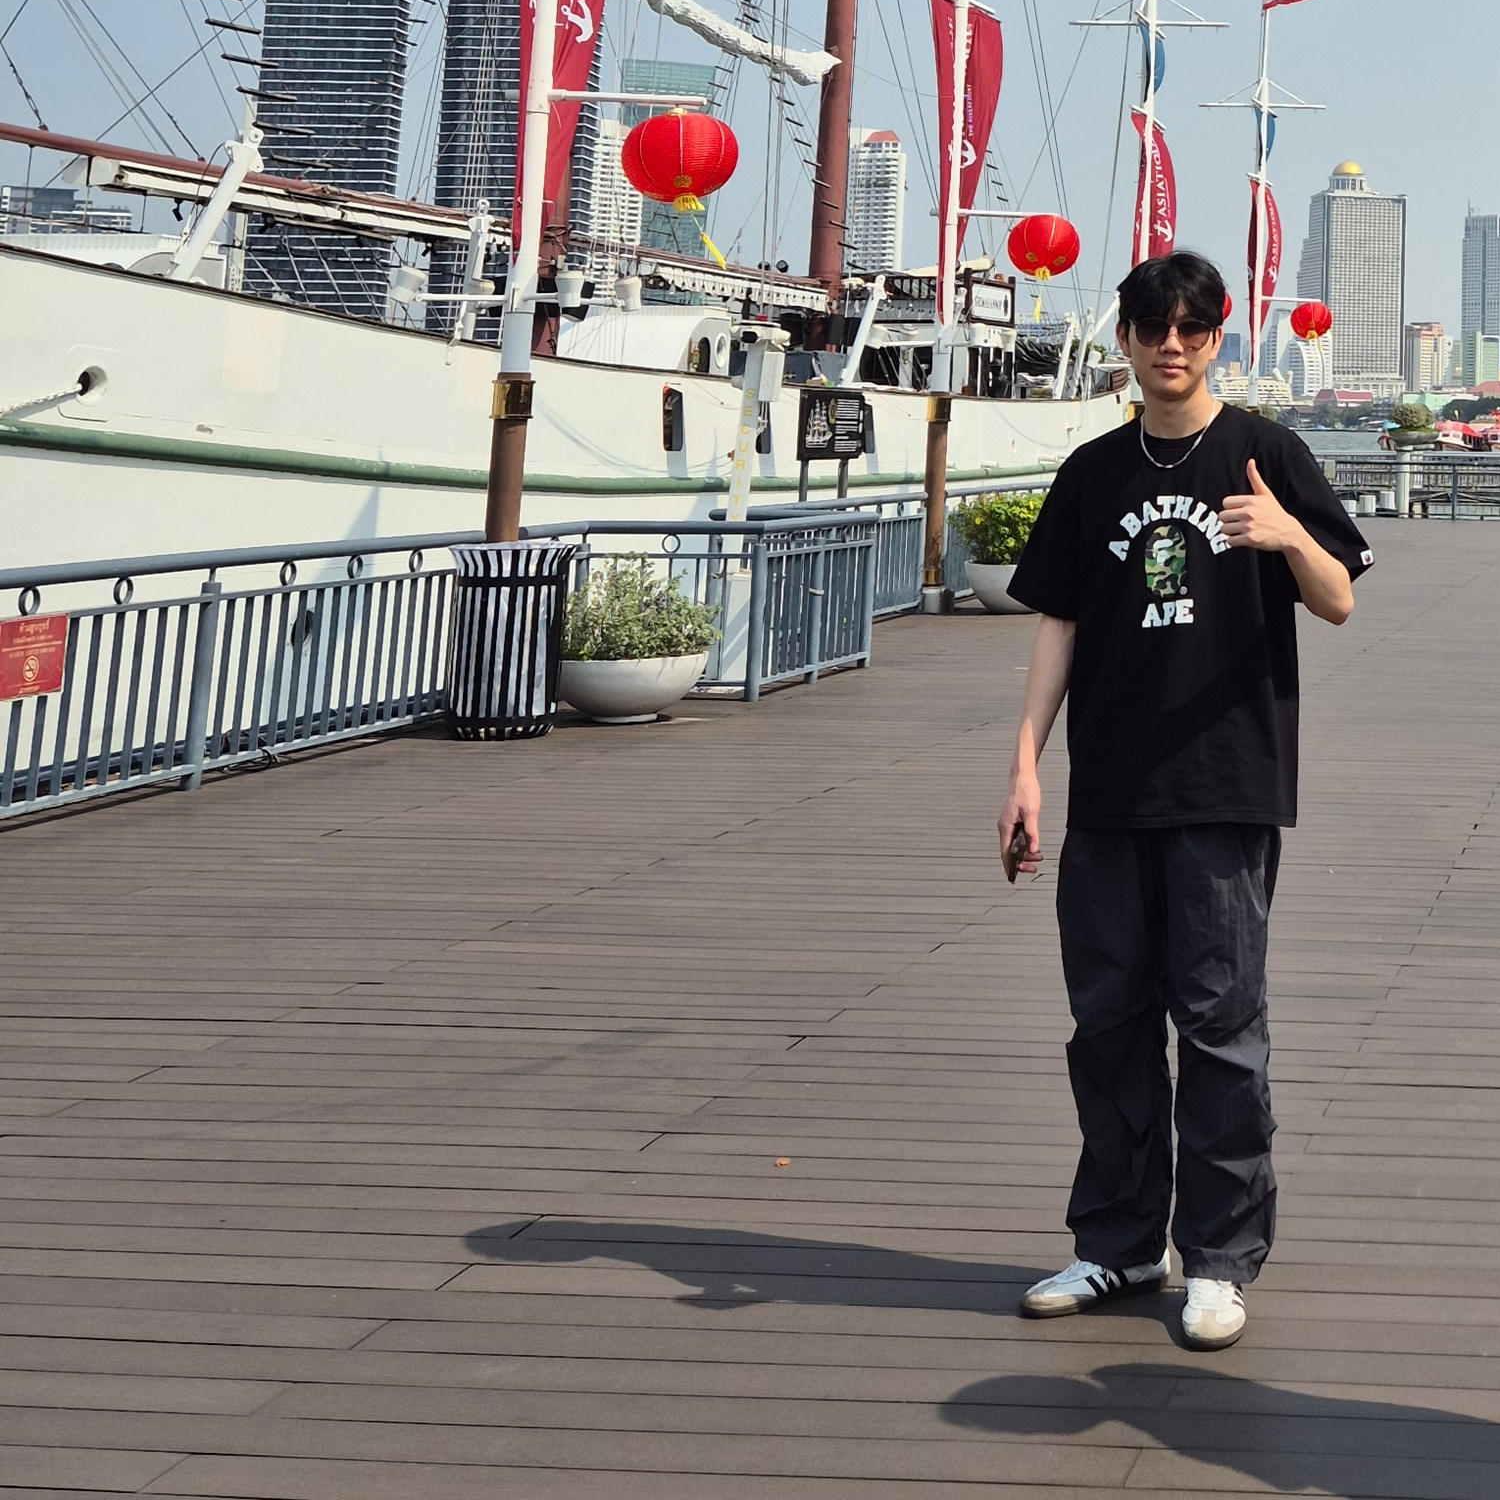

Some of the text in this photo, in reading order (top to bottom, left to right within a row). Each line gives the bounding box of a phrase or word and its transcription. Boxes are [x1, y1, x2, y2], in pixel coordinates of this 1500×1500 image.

[731, 387, 756, 522] SECURITY
[1108, 495, 1233, 561] A BATHING
[1141, 599, 1194, 628] APE
